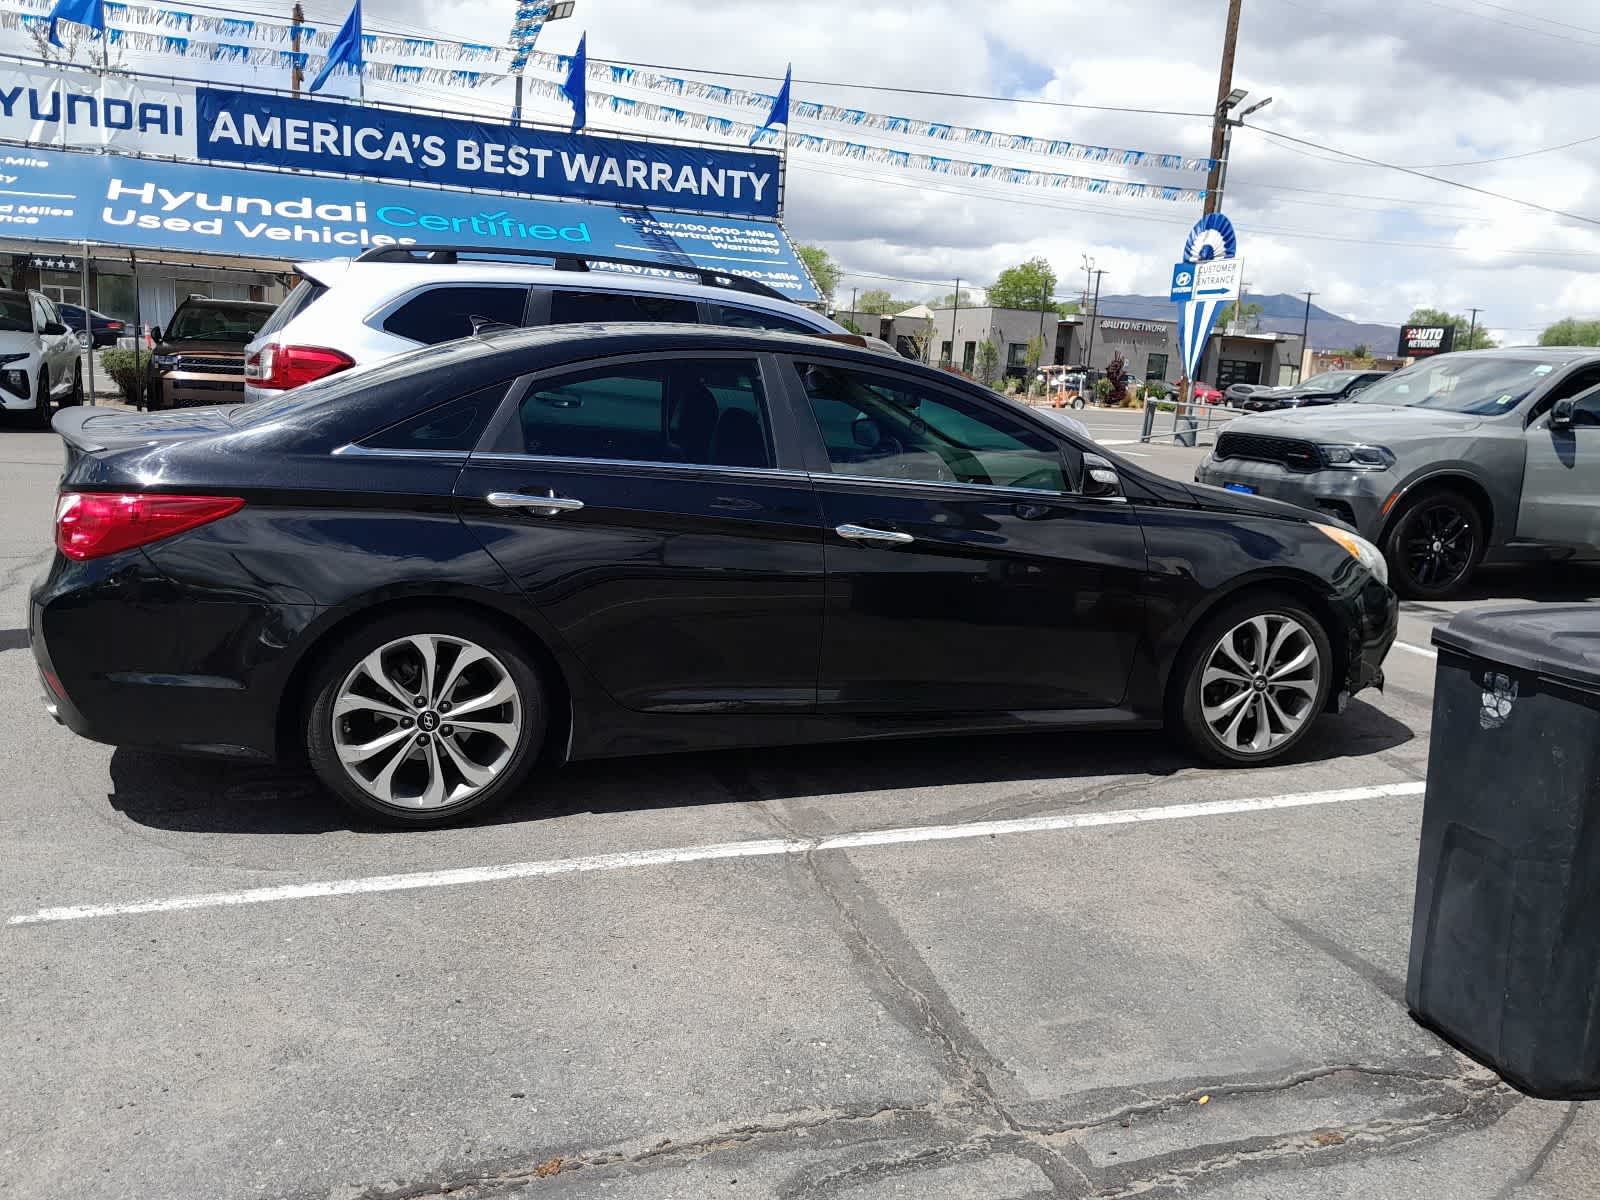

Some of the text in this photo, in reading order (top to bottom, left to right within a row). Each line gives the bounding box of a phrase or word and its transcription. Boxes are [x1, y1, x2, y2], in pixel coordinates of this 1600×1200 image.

[0, 86, 183, 136] YUNDAI
[209, 111, 771, 201] AMERICA'S BEST WARRANTY
[107, 178, 592, 243] Hyundai Certified
[102, 207, 223, 236] Used
[643, 227, 780, 247] Powertrain Limited
[712, 241, 780, 255] Warranty
[1199, 263, 1237, 274] CUSTOMER
[1197, 275, 1235, 286] ENTRANCE
[1131, 322, 1167, 333] NETWORK
[1415, 328, 1445, 340] AUTO
[1408, 339, 1441, 348] NETWORK
